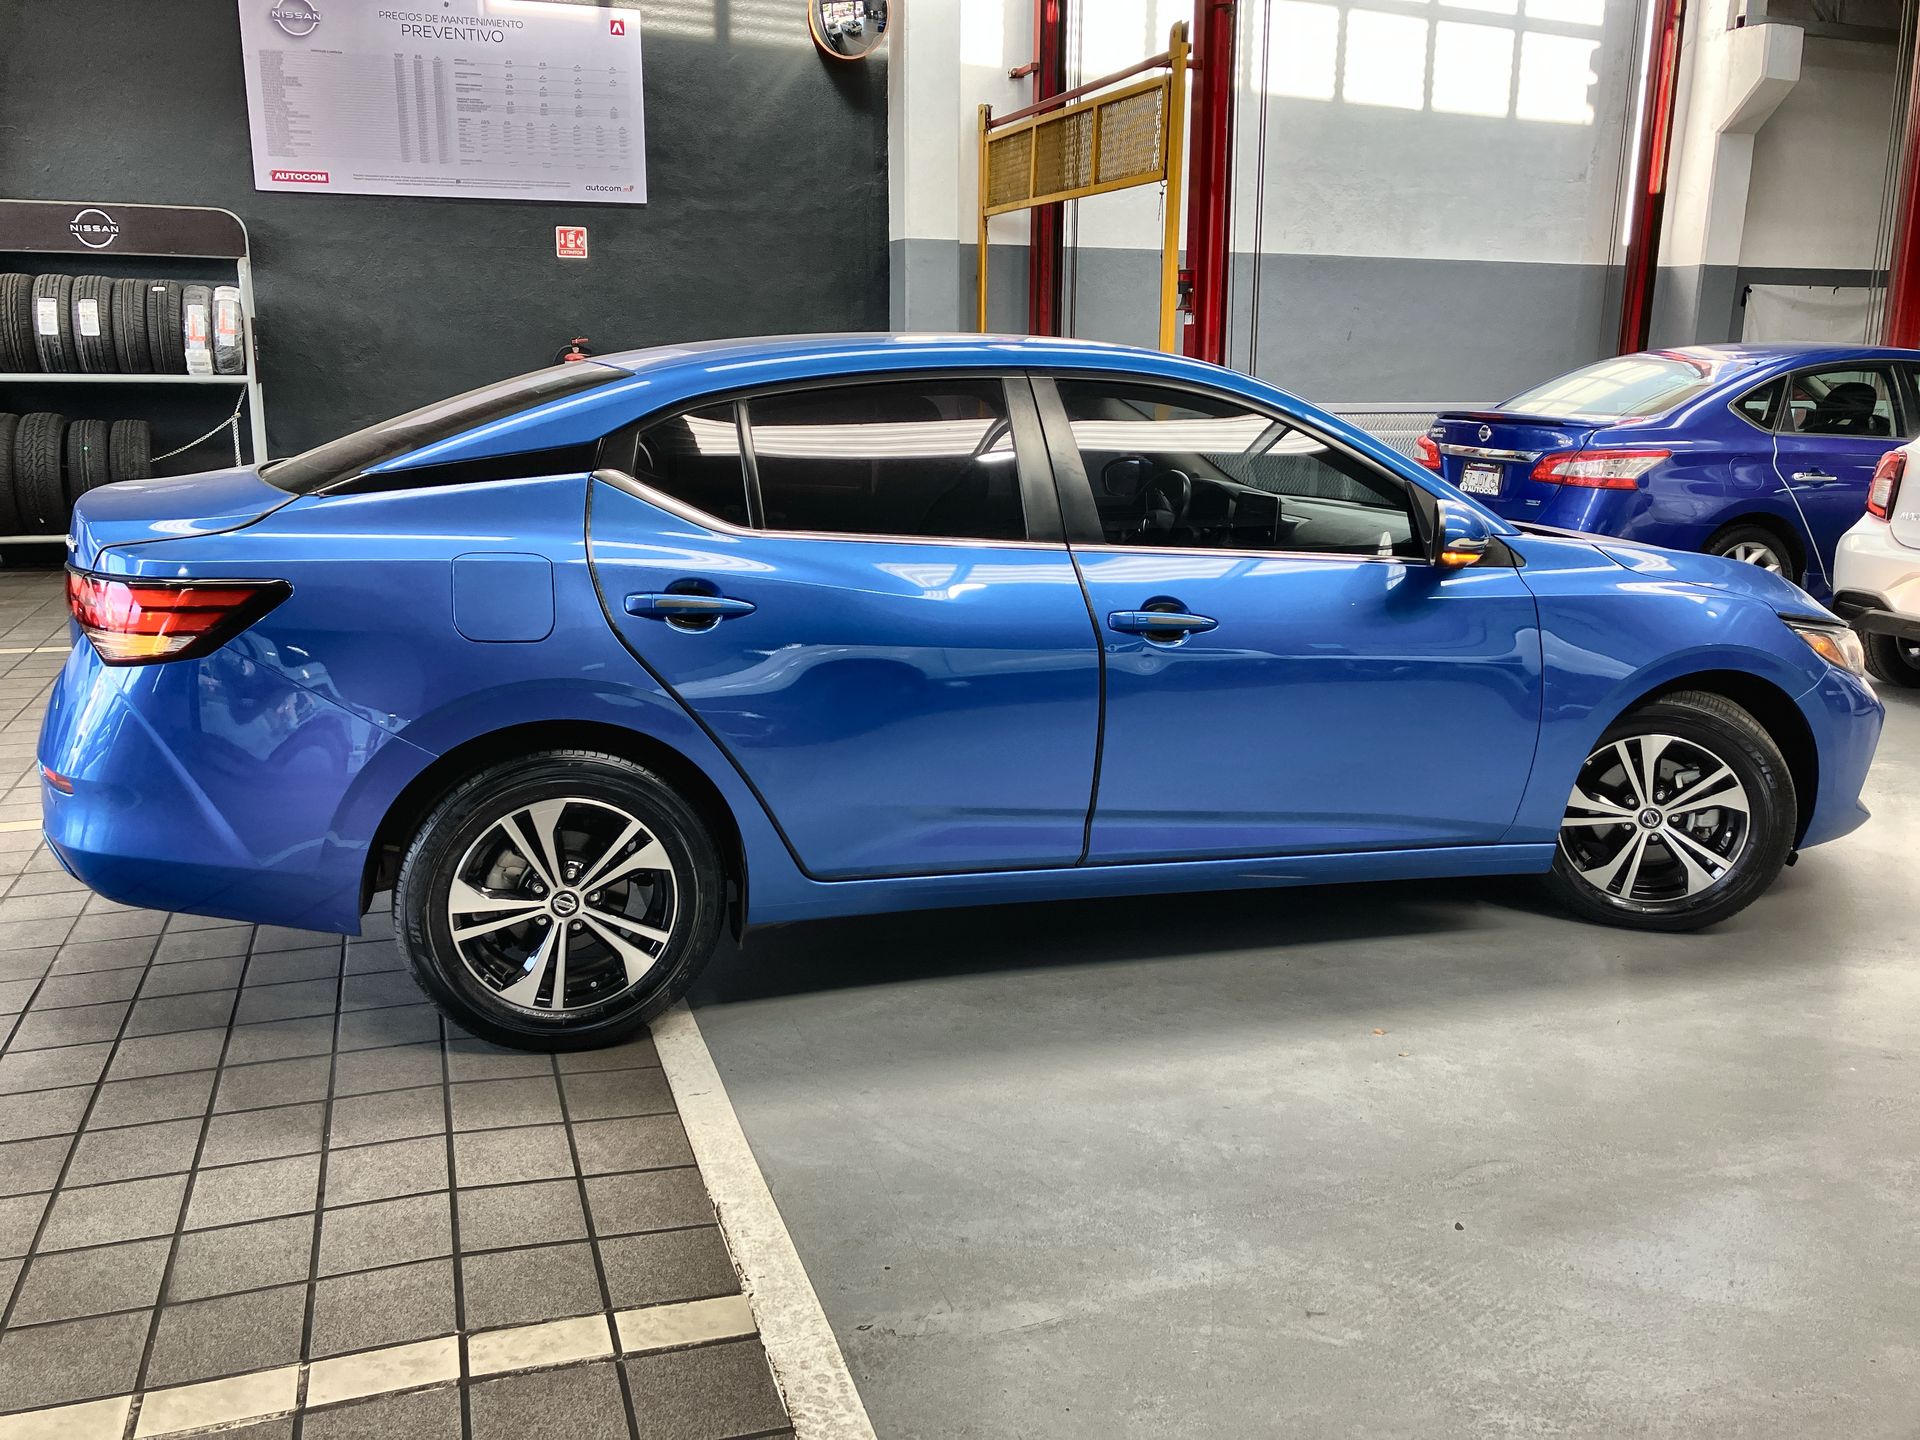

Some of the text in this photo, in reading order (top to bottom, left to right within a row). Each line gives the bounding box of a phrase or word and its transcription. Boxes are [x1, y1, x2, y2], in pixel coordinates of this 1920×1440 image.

[272, 10, 321, 21] NISSAN
[378, 10, 524, 29] PRECIOS DE MANTENIMIENTO
[401, 24, 504, 43] PREVENTIVO
[274, 171, 327, 182] AUTOCOM
[69, 224, 119, 233] NISSAN
[1467, 485, 1499, 496] AUTOCOM
